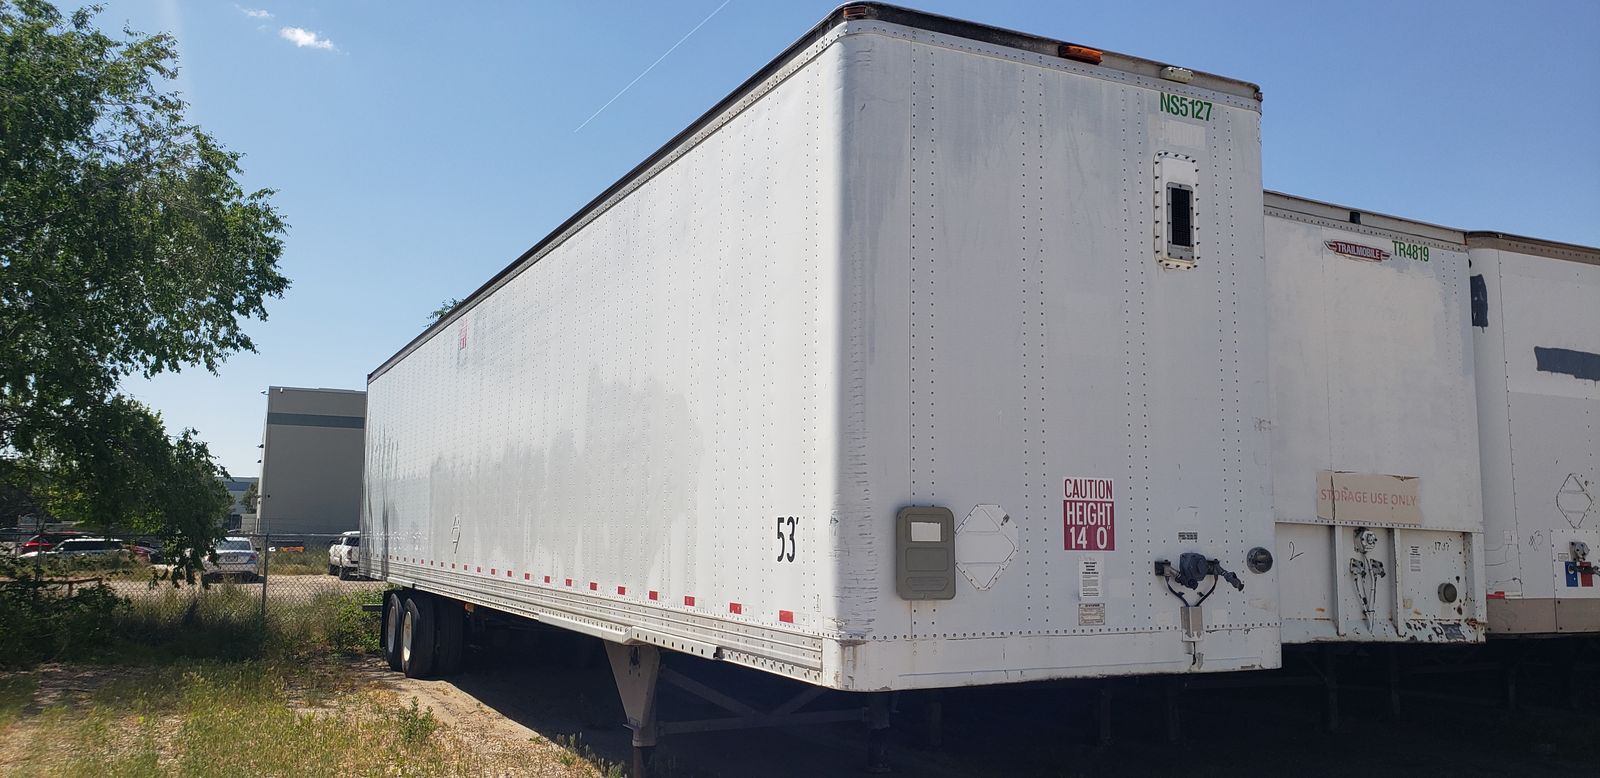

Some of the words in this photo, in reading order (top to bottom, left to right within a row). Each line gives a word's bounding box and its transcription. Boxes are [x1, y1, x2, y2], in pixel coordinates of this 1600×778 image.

[1160, 92, 1213, 121] NS5127
[1337, 242, 1381, 260] TRAILMOBILE
[1392, 240, 1430, 262] TR4819
[1064, 478, 1113, 499] CAUTION
[1320, 489, 1368, 503] STORAGE
[1370, 492, 1389, 505] USE
[1391, 494, 1417, 506] ONLY
[1066, 502, 1113, 526] HEIGHT
[776, 516, 799, 562] 53'
